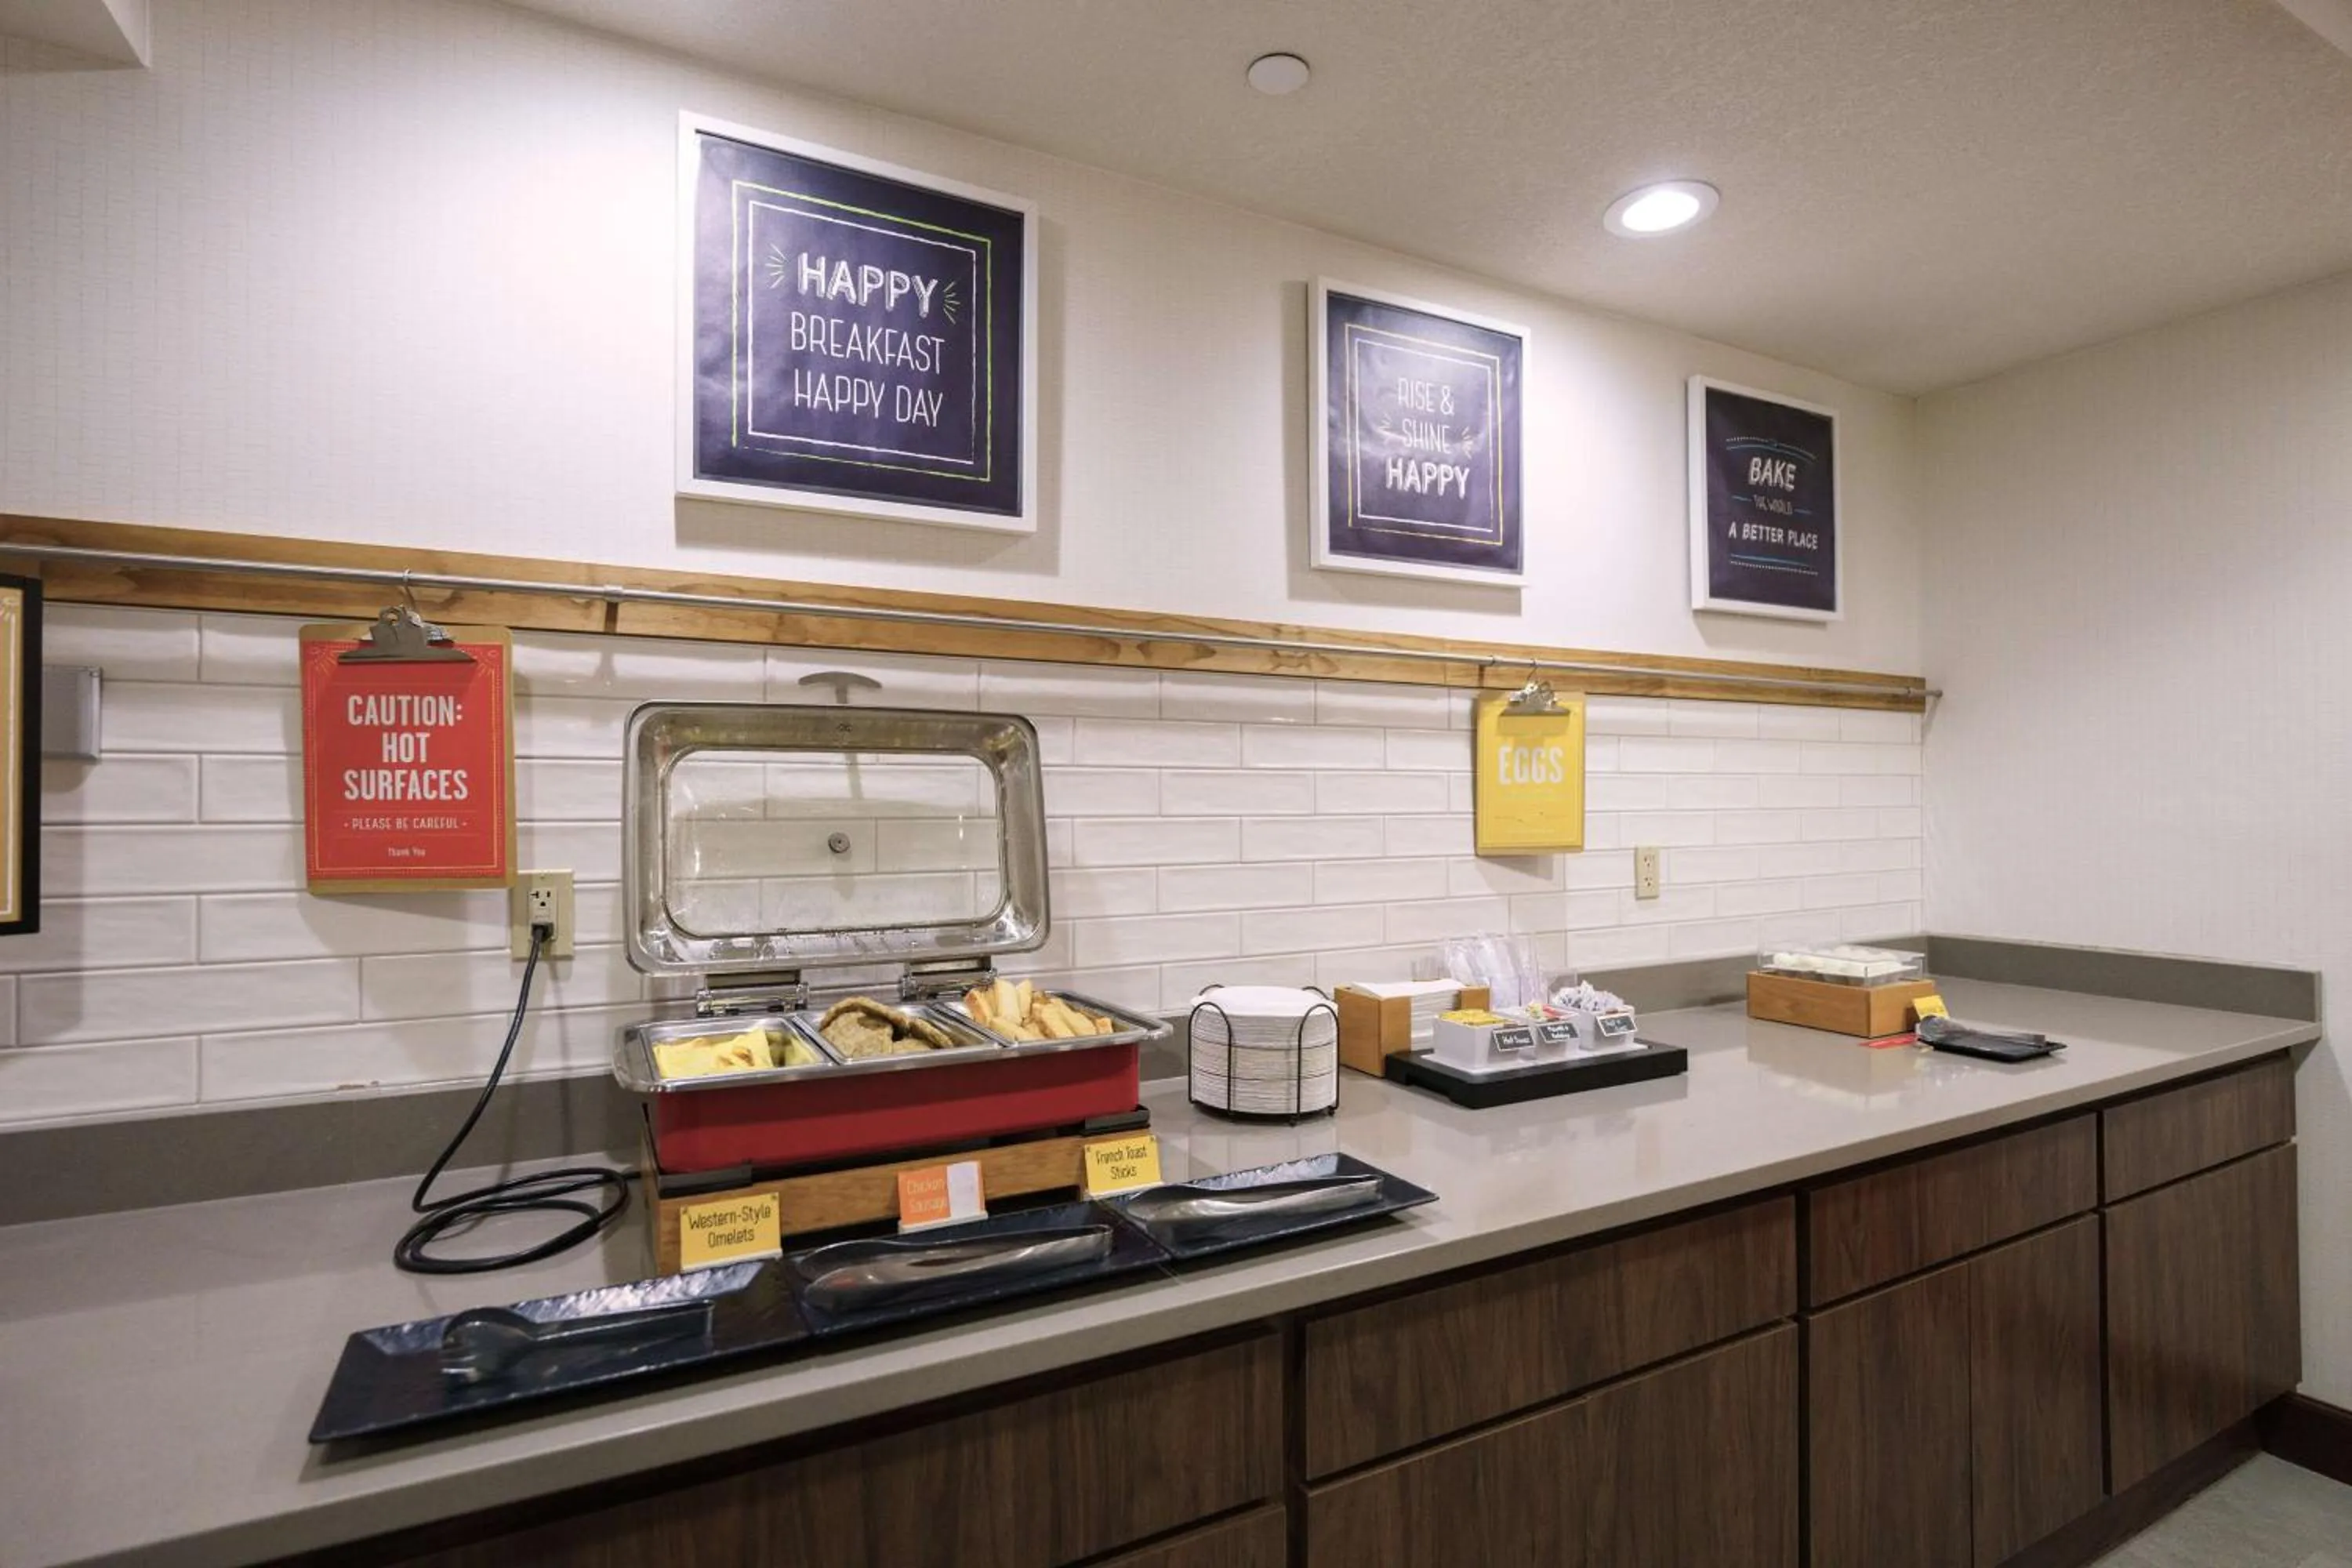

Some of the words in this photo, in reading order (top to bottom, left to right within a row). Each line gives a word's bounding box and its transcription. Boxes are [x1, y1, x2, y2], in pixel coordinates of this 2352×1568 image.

[797, 251, 938, 319] HAPPY
[790, 310, 946, 375] BREAKFAST
[793, 368, 885, 419] HAPPY
[895, 385, 943, 427] DAY
[1398, 377, 1434, 413] RISE
[1439, 386, 1455, 416] &
[1402, 418, 1450, 454] SHINE
[1386, 457, 1470, 499] HAPPY
[1748, 456, 1797, 492] BAKE
[1729, 521, 1737, 539] A
[1742, 523, 1784, 544] BETTER
[1788, 529, 1818, 550] PLACE
[347, 695, 463, 727] CAUTION:
[382, 731, 430, 764] HOT
[1498, 746, 1564, 785] EGGS
[343, 769, 468, 800] SURFACES
[352, 818, 391, 829] PLEASE
[397, 818, 408, 829] BE
[413, 816, 459, 829] CAREFUL
[412, 847, 426, 856] You
[1096, 1147, 1123, 1166] French
[1126, 1145, 1147, 1160] Toast
[1111, 1165, 1137, 1180] Sticks
[688, 1203, 771, 1230] Western-Style
[708, 1229, 755, 1248] Omelets
